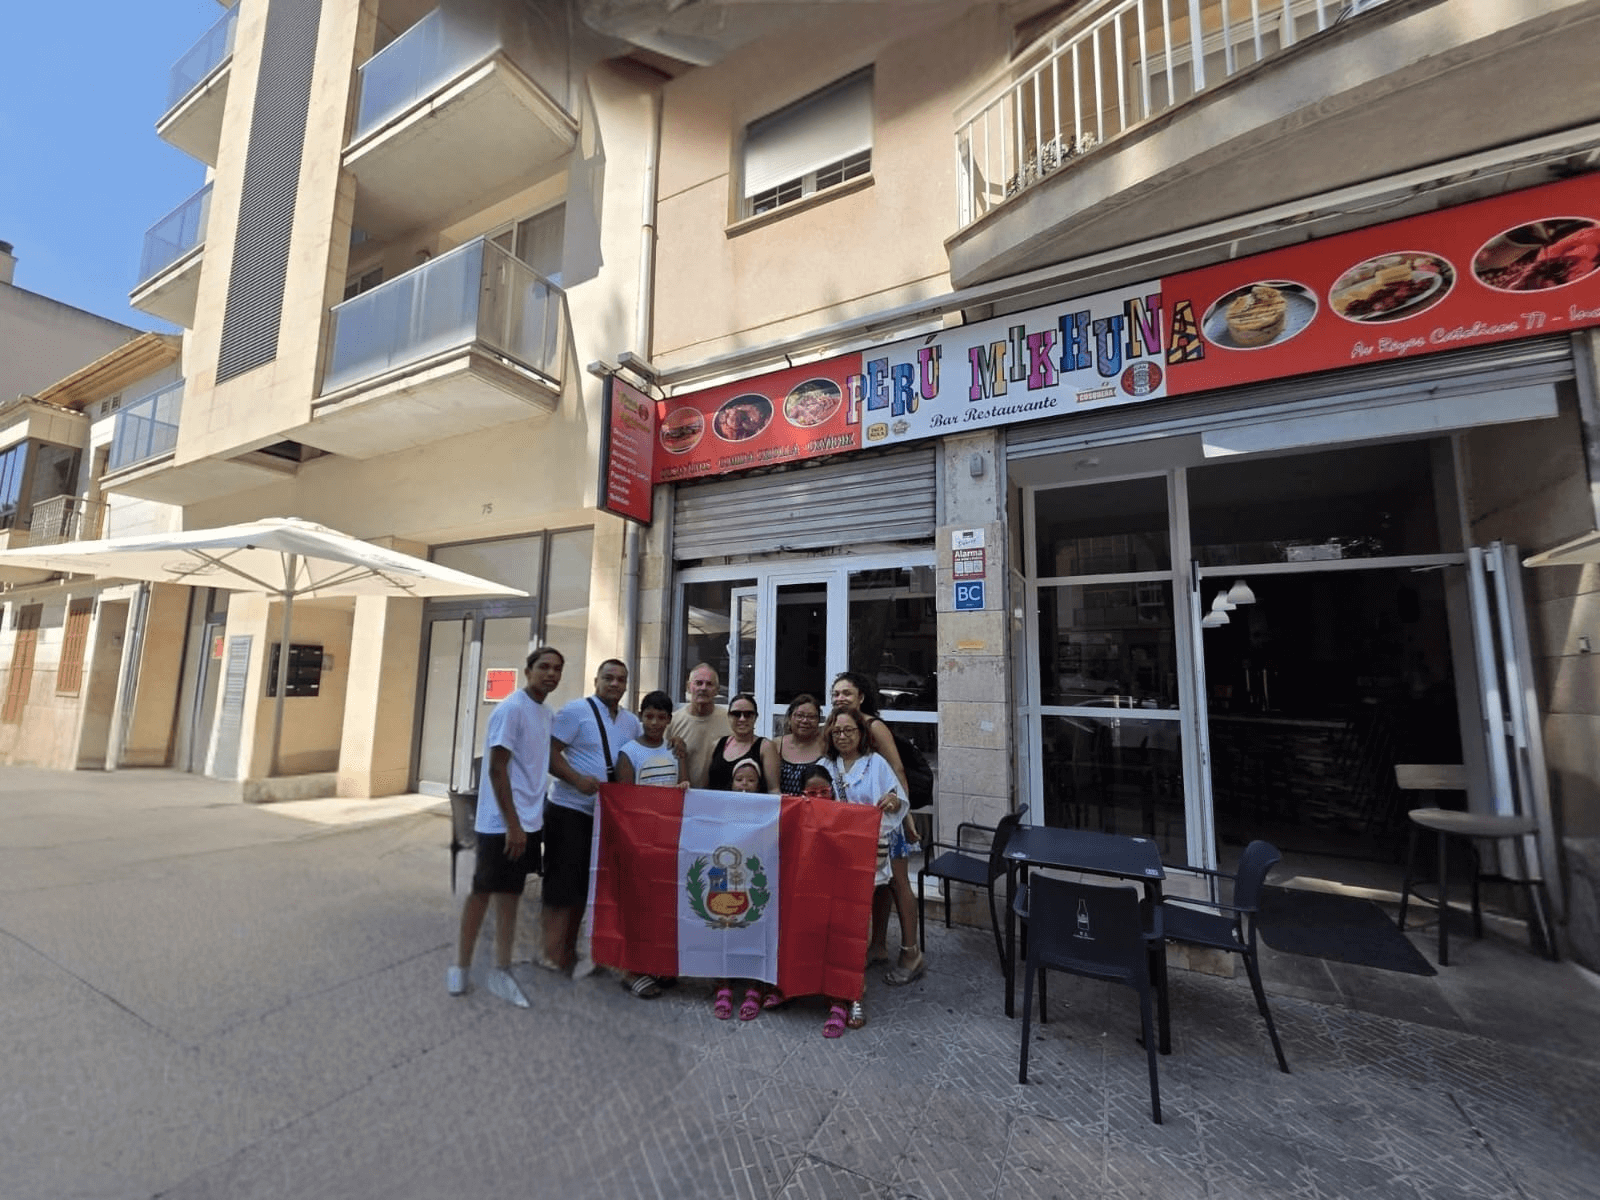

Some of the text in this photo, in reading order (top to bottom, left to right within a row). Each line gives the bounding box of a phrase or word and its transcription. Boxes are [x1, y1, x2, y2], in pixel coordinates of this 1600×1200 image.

[847, 292, 1205, 425] PERÚ MIKHUNA
[929, 396, 1057, 428] Bar Restaurante
[481, 503, 493, 515] 75
[954, 550, 983, 558] Alarma
[958, 585, 981, 602] BC
